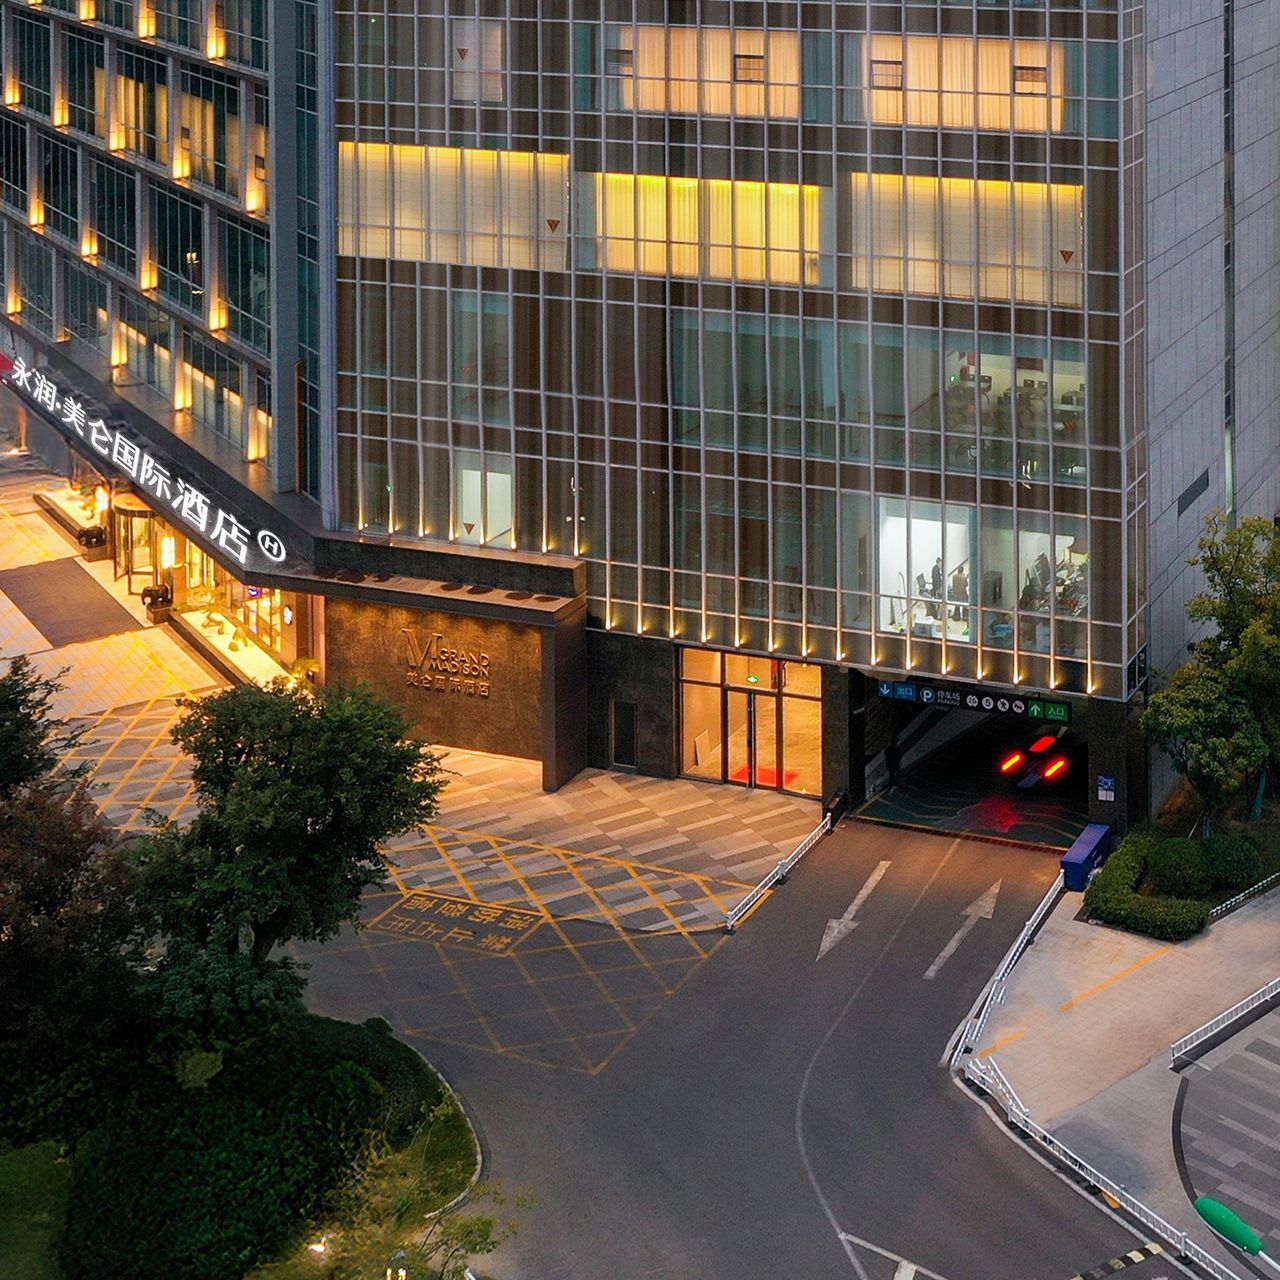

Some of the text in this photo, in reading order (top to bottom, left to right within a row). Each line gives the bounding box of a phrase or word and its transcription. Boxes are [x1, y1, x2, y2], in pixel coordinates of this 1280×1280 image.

[440, 647, 490, 667] GRAND
[430, 658, 490, 680] MADISON
[1048, 707, 1065, 717] 入口
